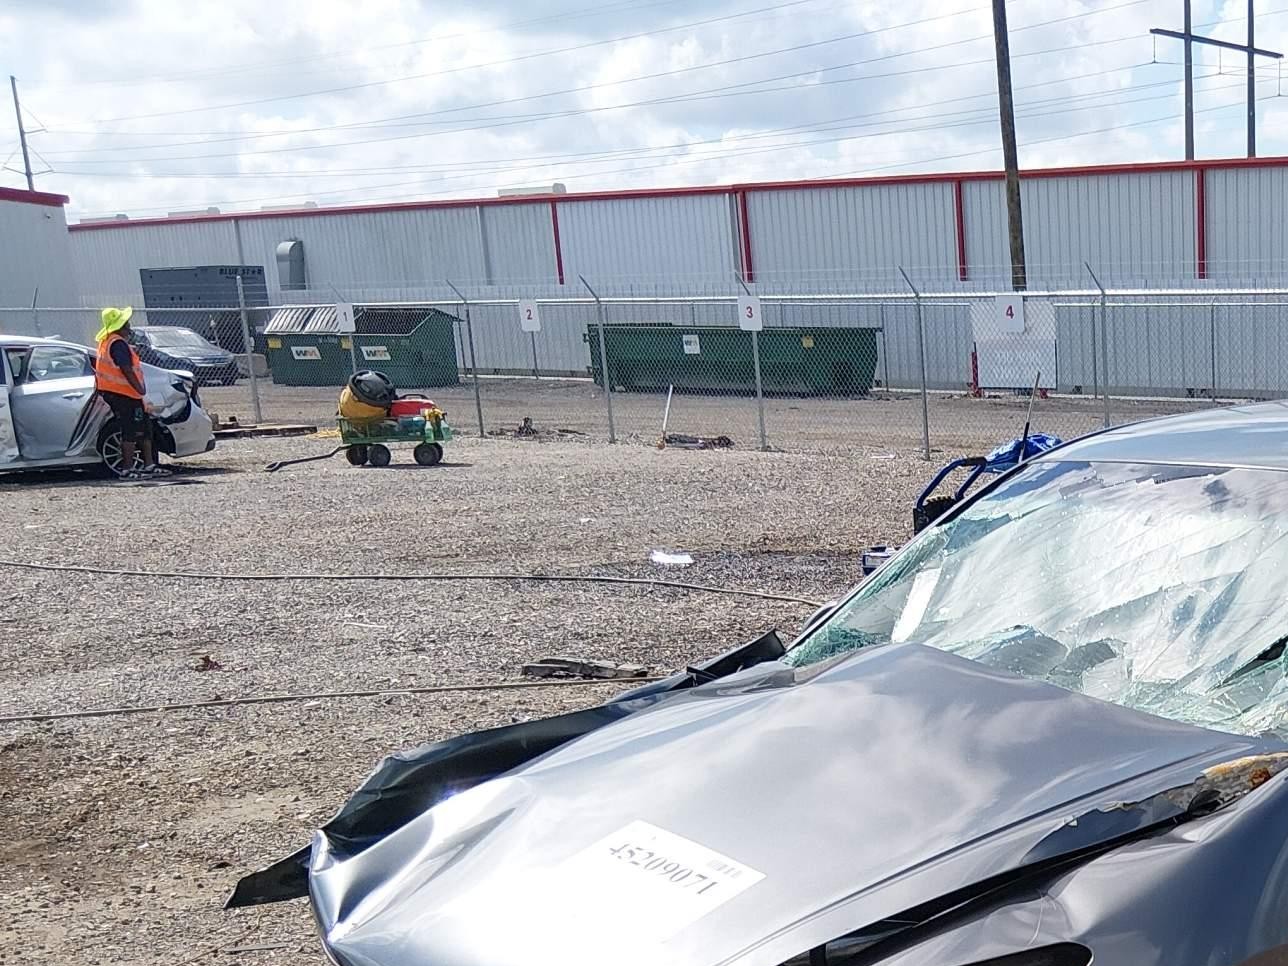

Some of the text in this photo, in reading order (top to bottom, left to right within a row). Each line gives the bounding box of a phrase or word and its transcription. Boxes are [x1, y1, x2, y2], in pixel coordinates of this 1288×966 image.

[343, 311, 348, 321] 1
[526, 309, 533, 320] 2
[746, 305, 754, 319] 3
[1005, 304, 1015, 319] 4
[609, 843, 717, 894] 45209071
